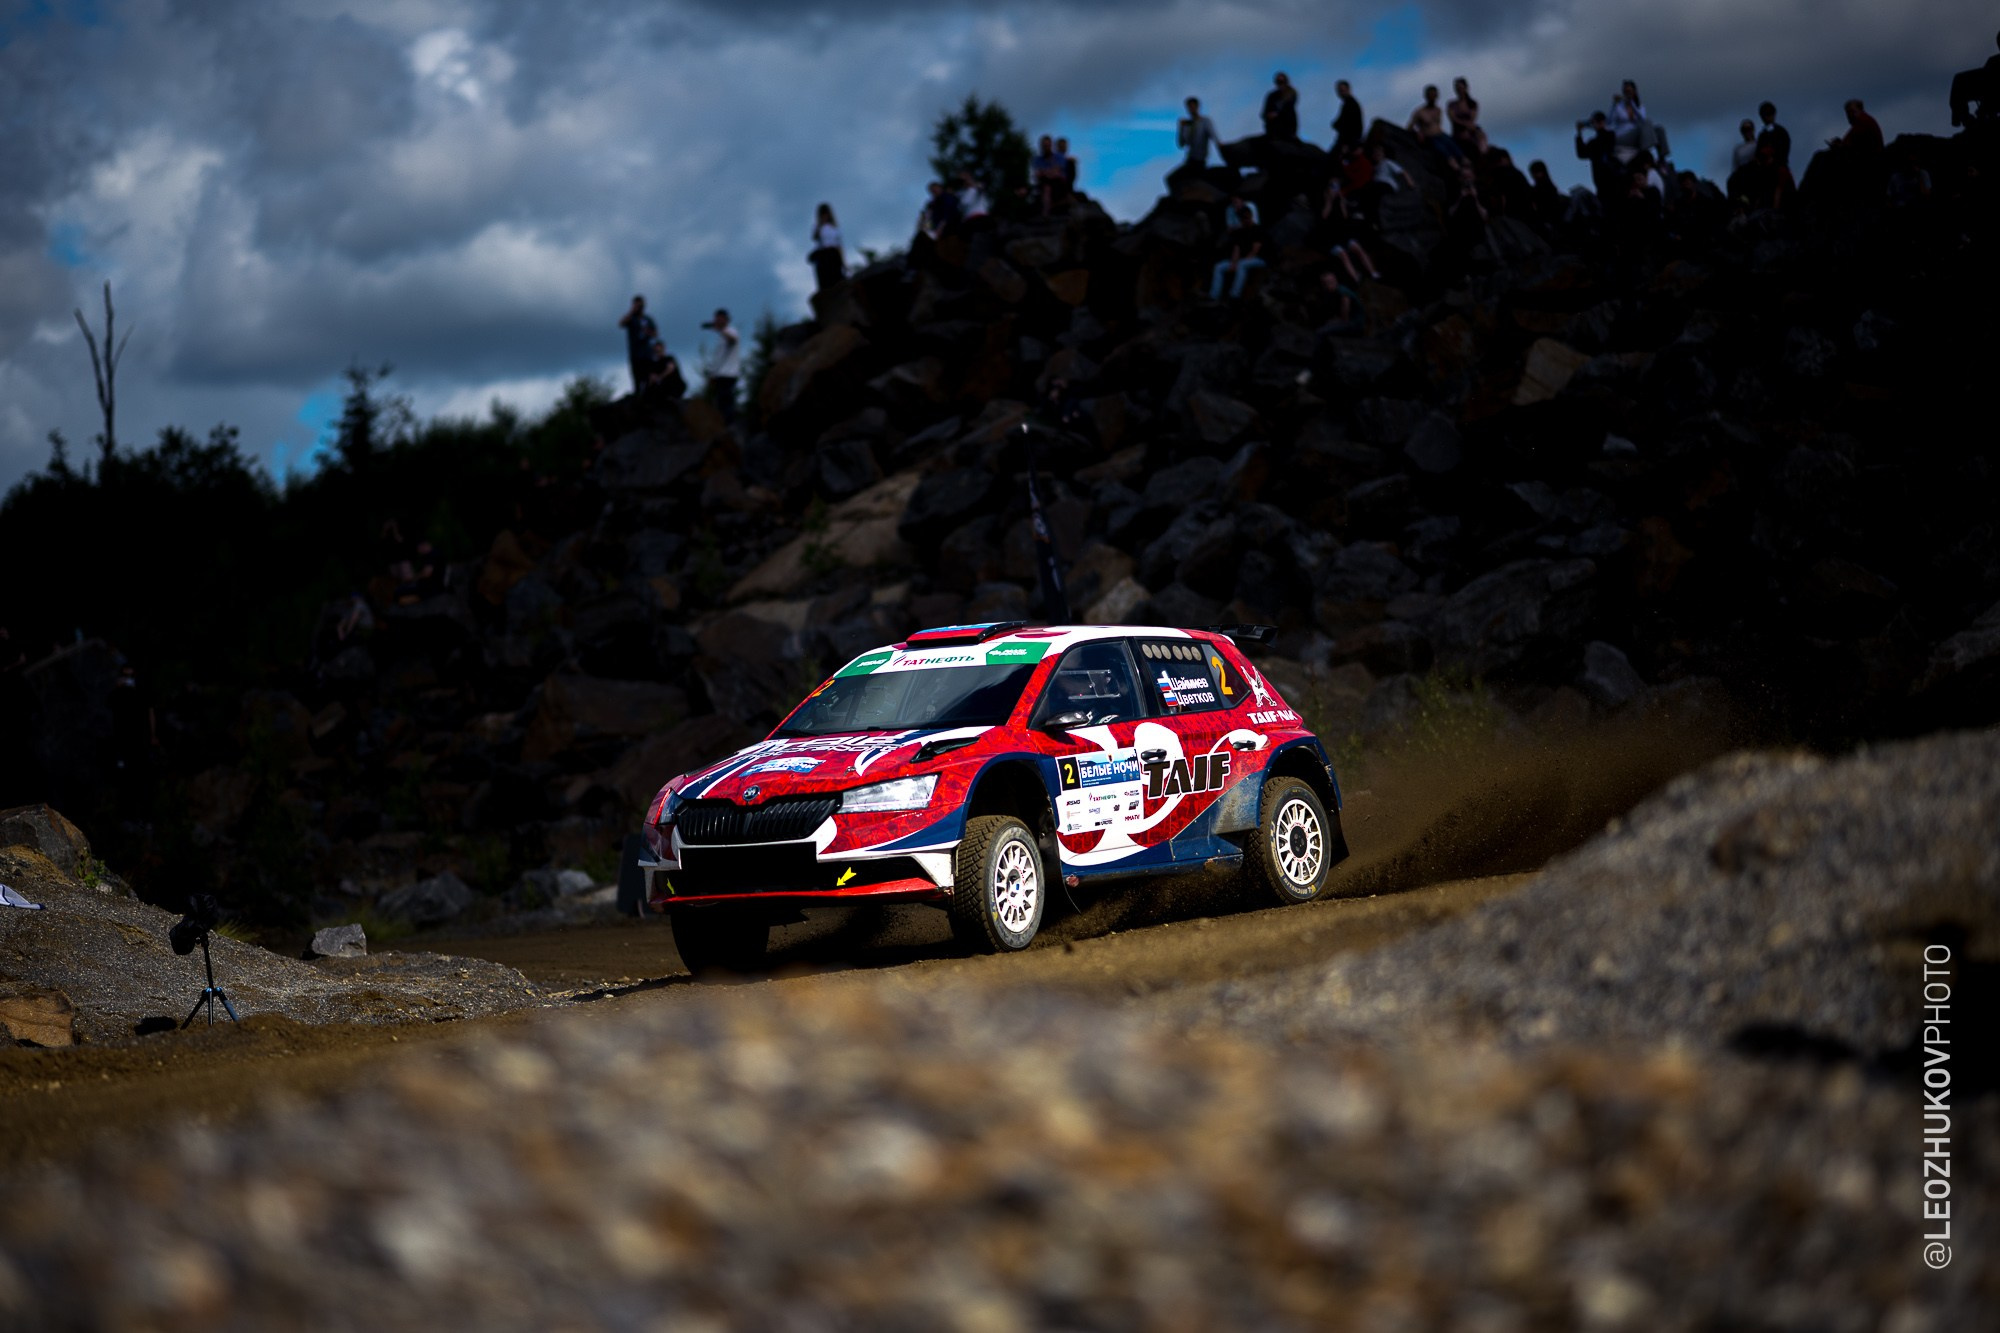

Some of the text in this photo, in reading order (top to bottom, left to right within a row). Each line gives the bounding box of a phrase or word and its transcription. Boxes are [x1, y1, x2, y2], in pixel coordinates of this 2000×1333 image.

[903, 655, 975, 666] ТАТНЕФТЬ
[1211, 656, 1234, 695] 2
[1170, 677, 1209, 691] Шаймиев
[1176, 692, 1215, 706] Цветков
[1247, 710, 1298, 724] TAIF-NK
[1064, 763, 1075, 784] 2
[1080, 760, 1139, 779] БЕЛЫЕ НОЧИ
[1143, 752, 1230, 799] TAIF
